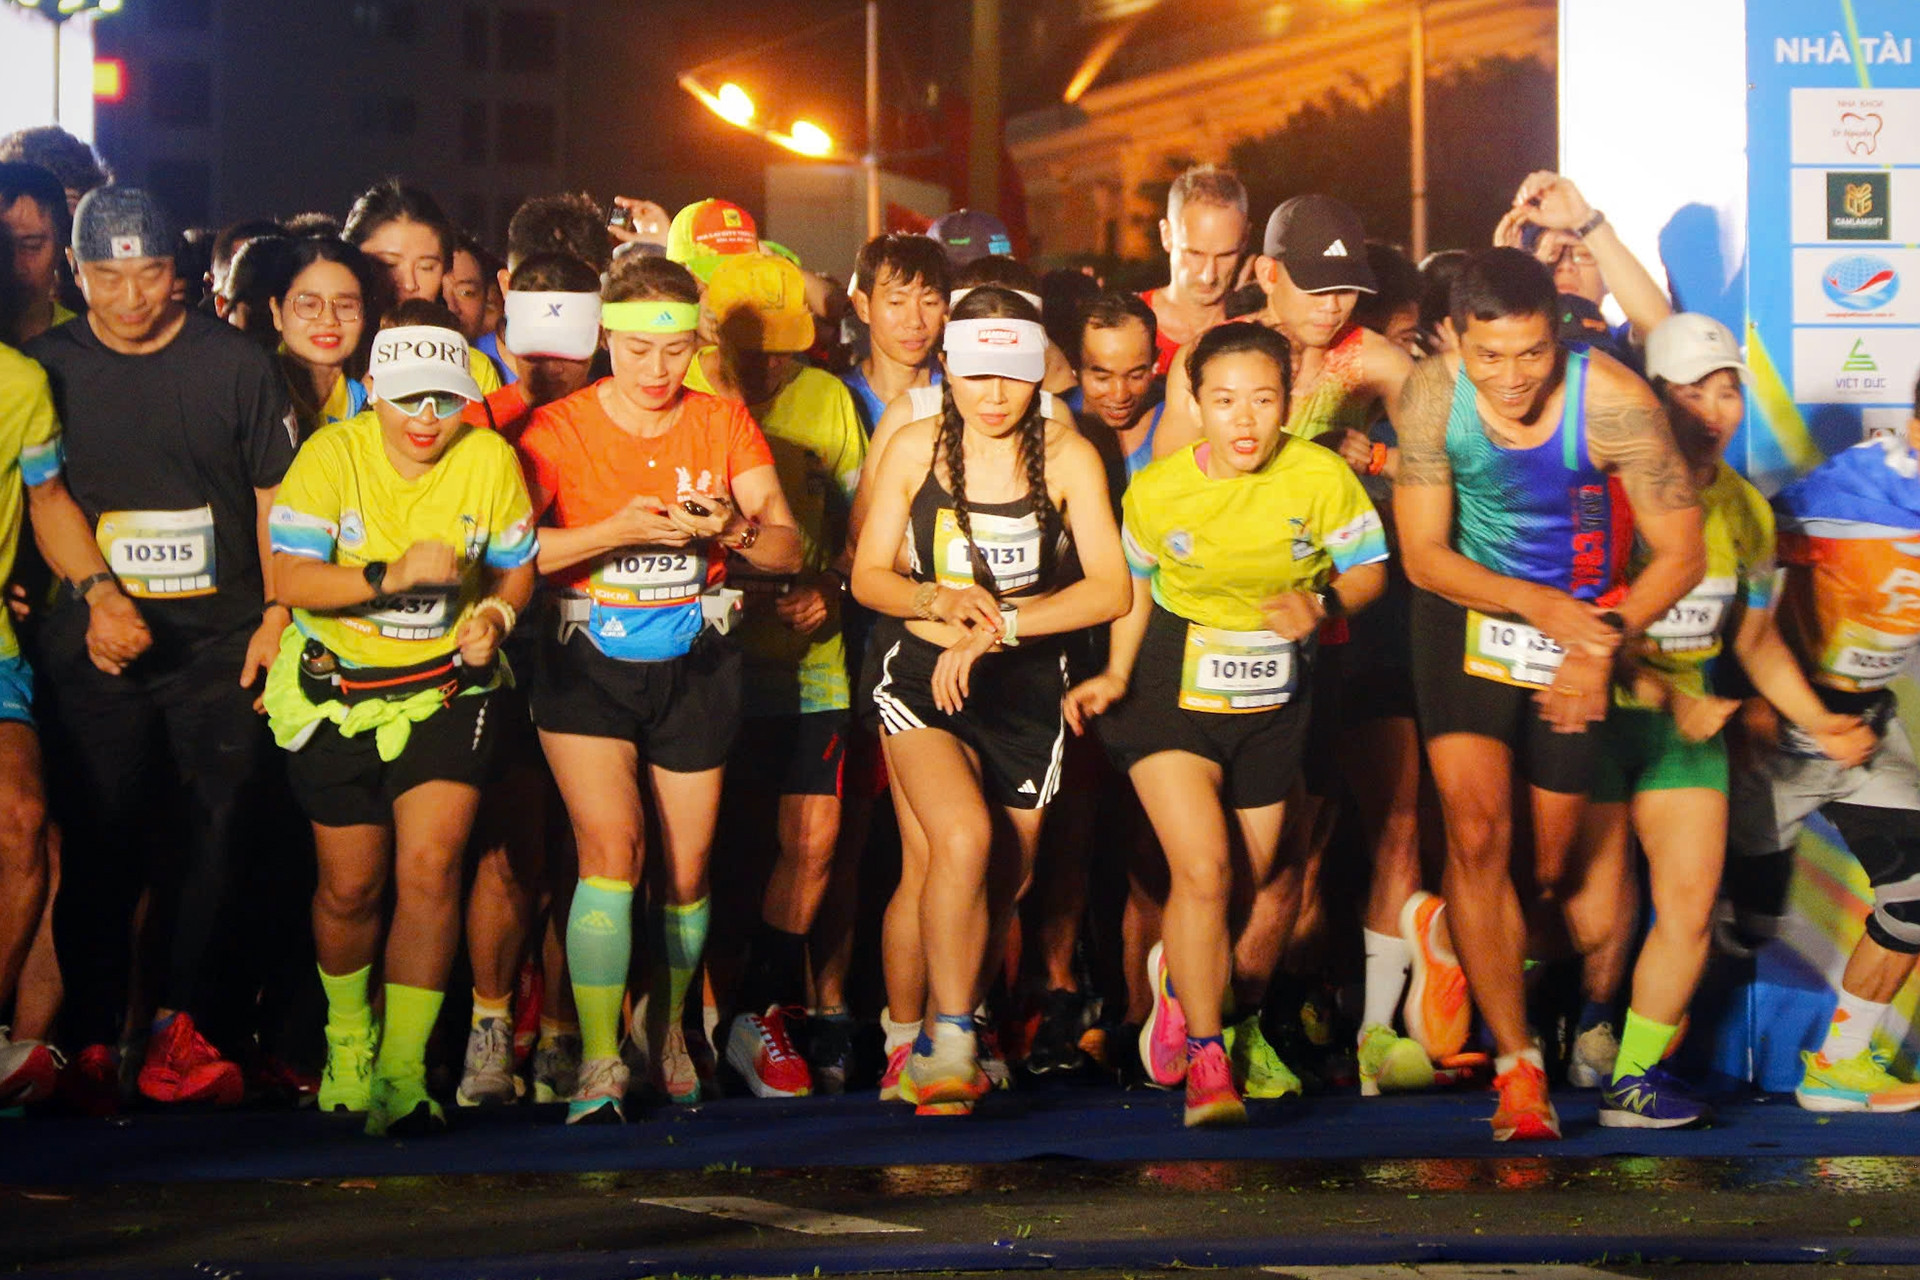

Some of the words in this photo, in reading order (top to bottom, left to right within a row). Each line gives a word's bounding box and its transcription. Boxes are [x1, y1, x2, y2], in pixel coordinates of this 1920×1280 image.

[1775, 31, 1852, 64] NHÀ
[1858, 31, 1912, 64] TÀI
[377, 340, 467, 369] SPORT
[124, 543, 193, 562] 10315
[612, 554, 687, 574] 10792
[1212, 659, 1278, 680] 10168
